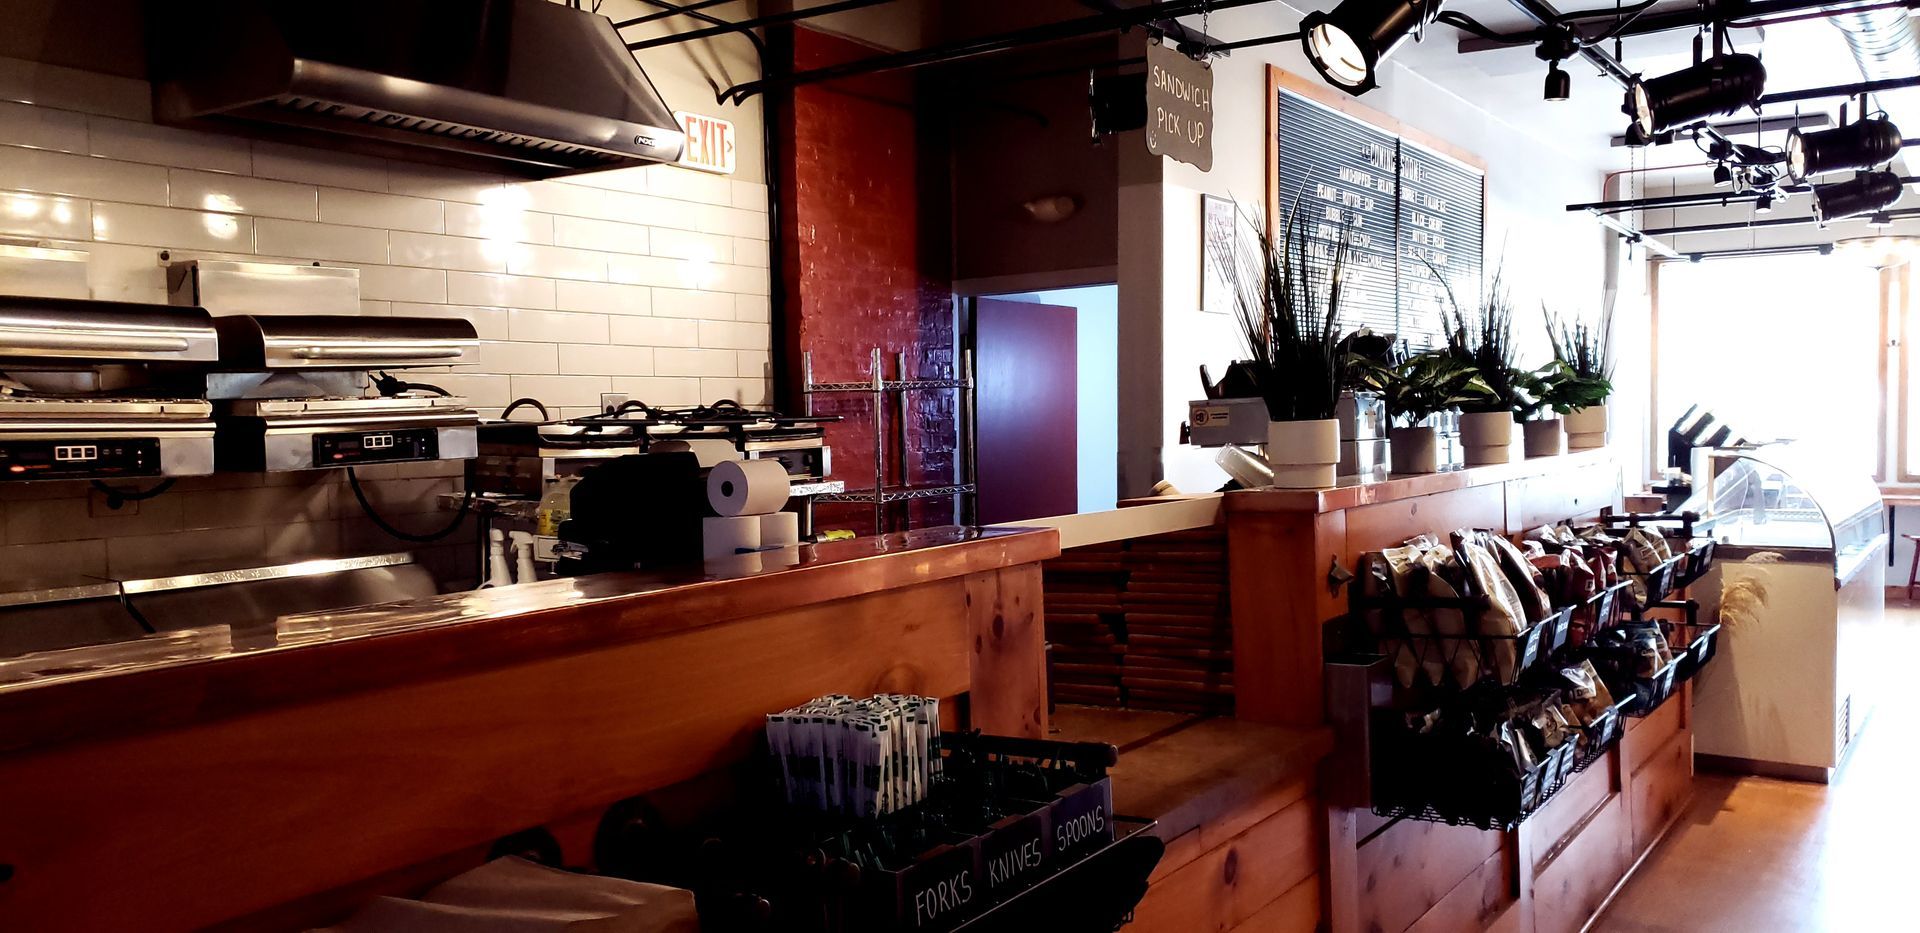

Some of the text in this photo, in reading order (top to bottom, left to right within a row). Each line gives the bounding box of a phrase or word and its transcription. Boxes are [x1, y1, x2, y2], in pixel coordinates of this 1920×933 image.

[1153, 65, 1210, 113] SANDWICH
[685, 115, 727, 168] EXIT
[1157, 106, 1205, 148] PICK UP
[1056, 805, 1105, 852] SPOONS
[988, 837, 1042, 888] KNIVES
[915, 870, 972, 927] FORKS
